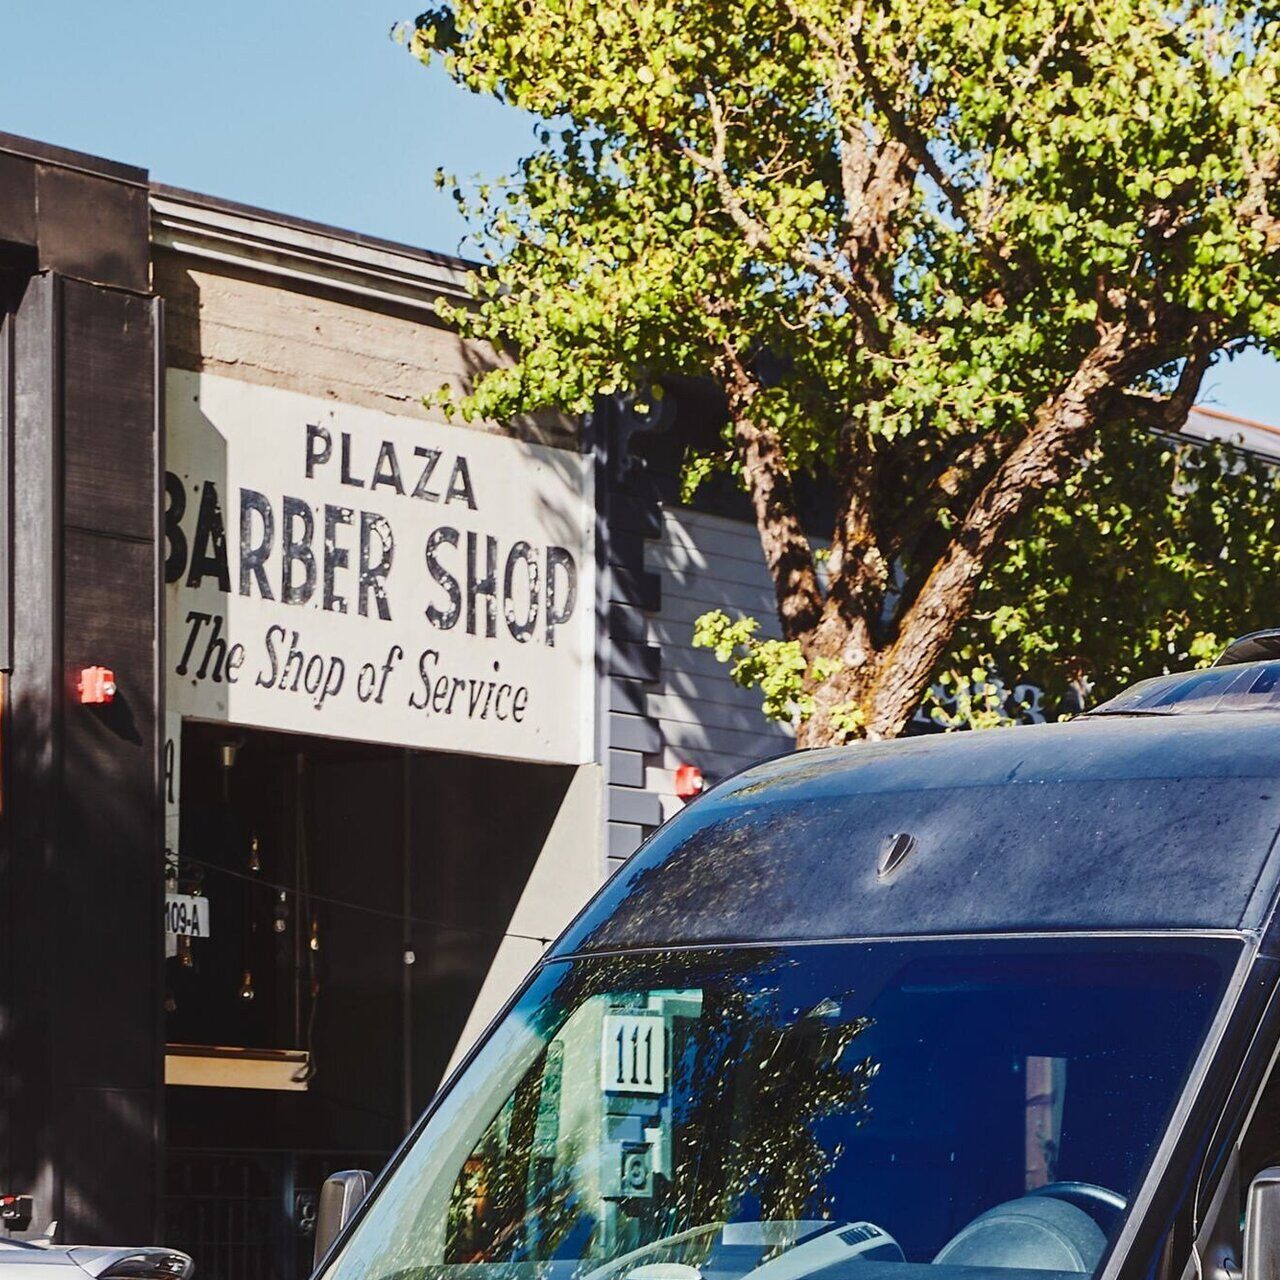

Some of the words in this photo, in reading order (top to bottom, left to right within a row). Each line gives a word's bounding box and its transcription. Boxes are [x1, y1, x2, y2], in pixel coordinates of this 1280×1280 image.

[305, 423, 479, 511] PLAZA
[164, 470, 394, 622] BARBER
[425, 526, 579, 648] SHOP
[175, 610, 246, 684] The
[255, 624, 346, 711] Shop
[357, 644, 404, 704] of
[409, 648, 529, 724] Service
[616, 1025, 653, 1086] 111
